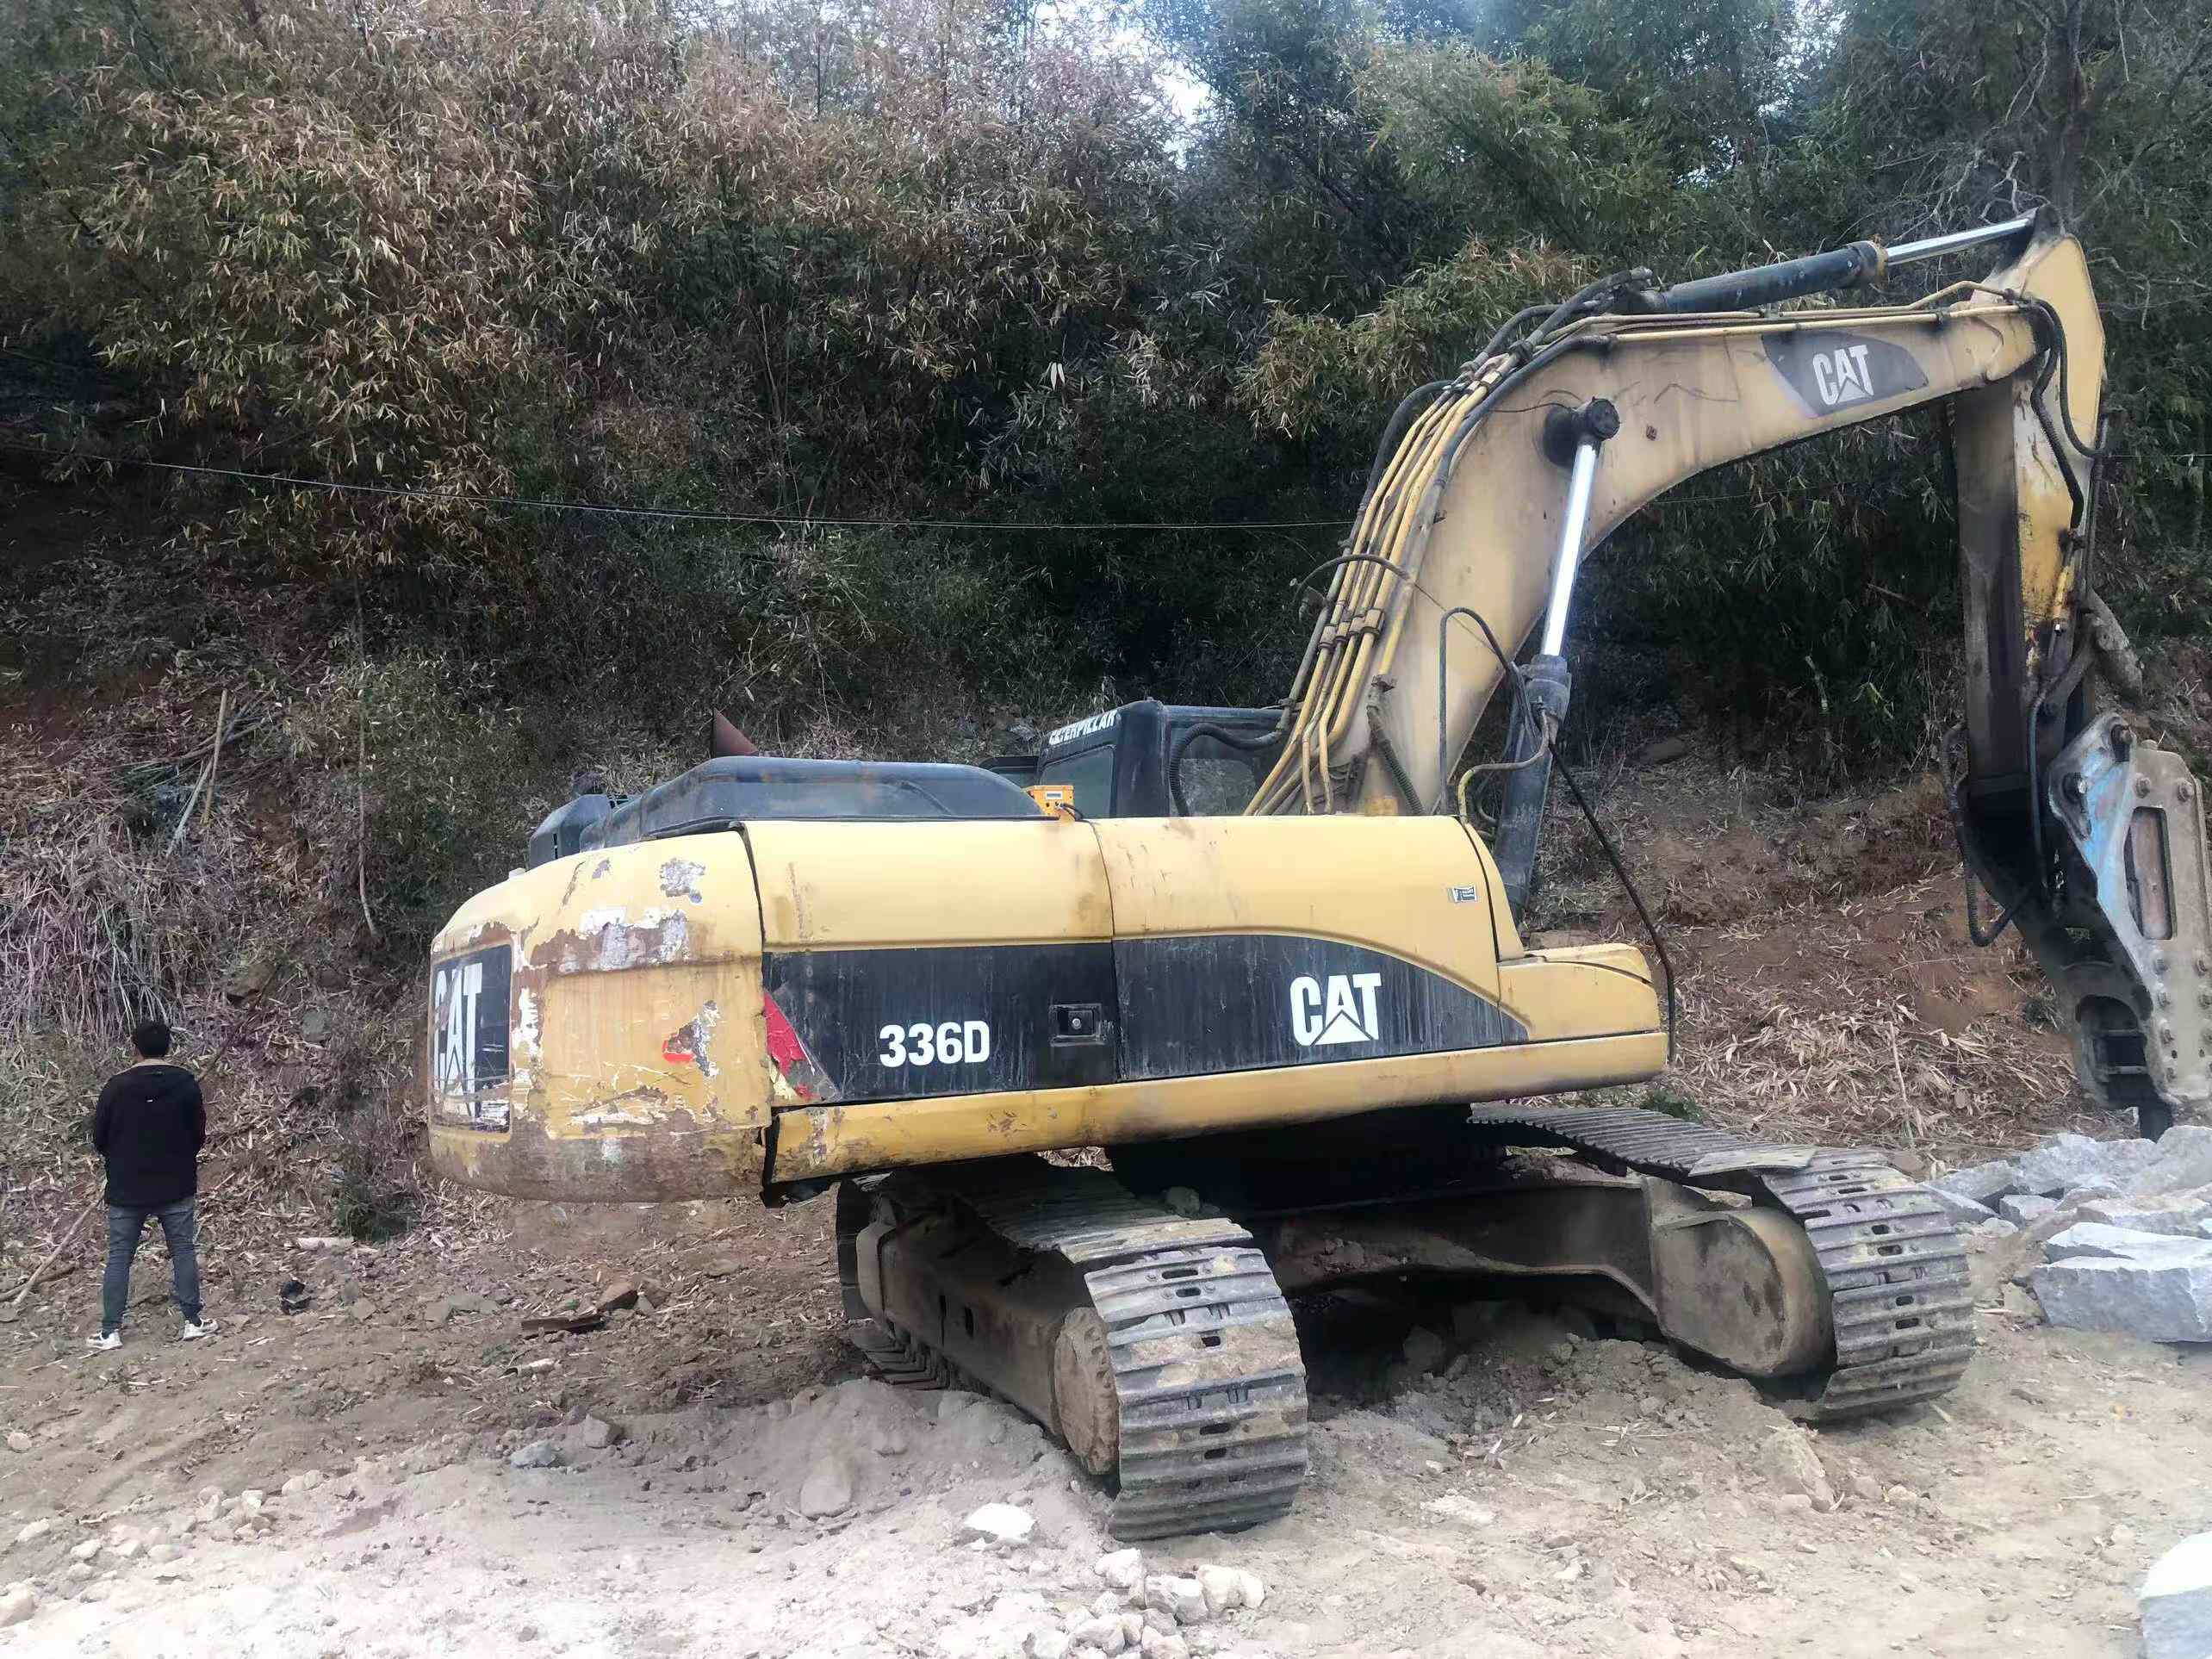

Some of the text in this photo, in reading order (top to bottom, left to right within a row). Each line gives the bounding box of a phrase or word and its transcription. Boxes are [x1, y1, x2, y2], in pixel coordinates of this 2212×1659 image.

[1812, 345, 1874, 406] CAT
[1048, 709, 1118, 746] CATERPILLAR
[434, 962, 482, 1118] CAT
[1289, 972, 1382, 1047] CAT
[879, 1020, 991, 1067] 336D
